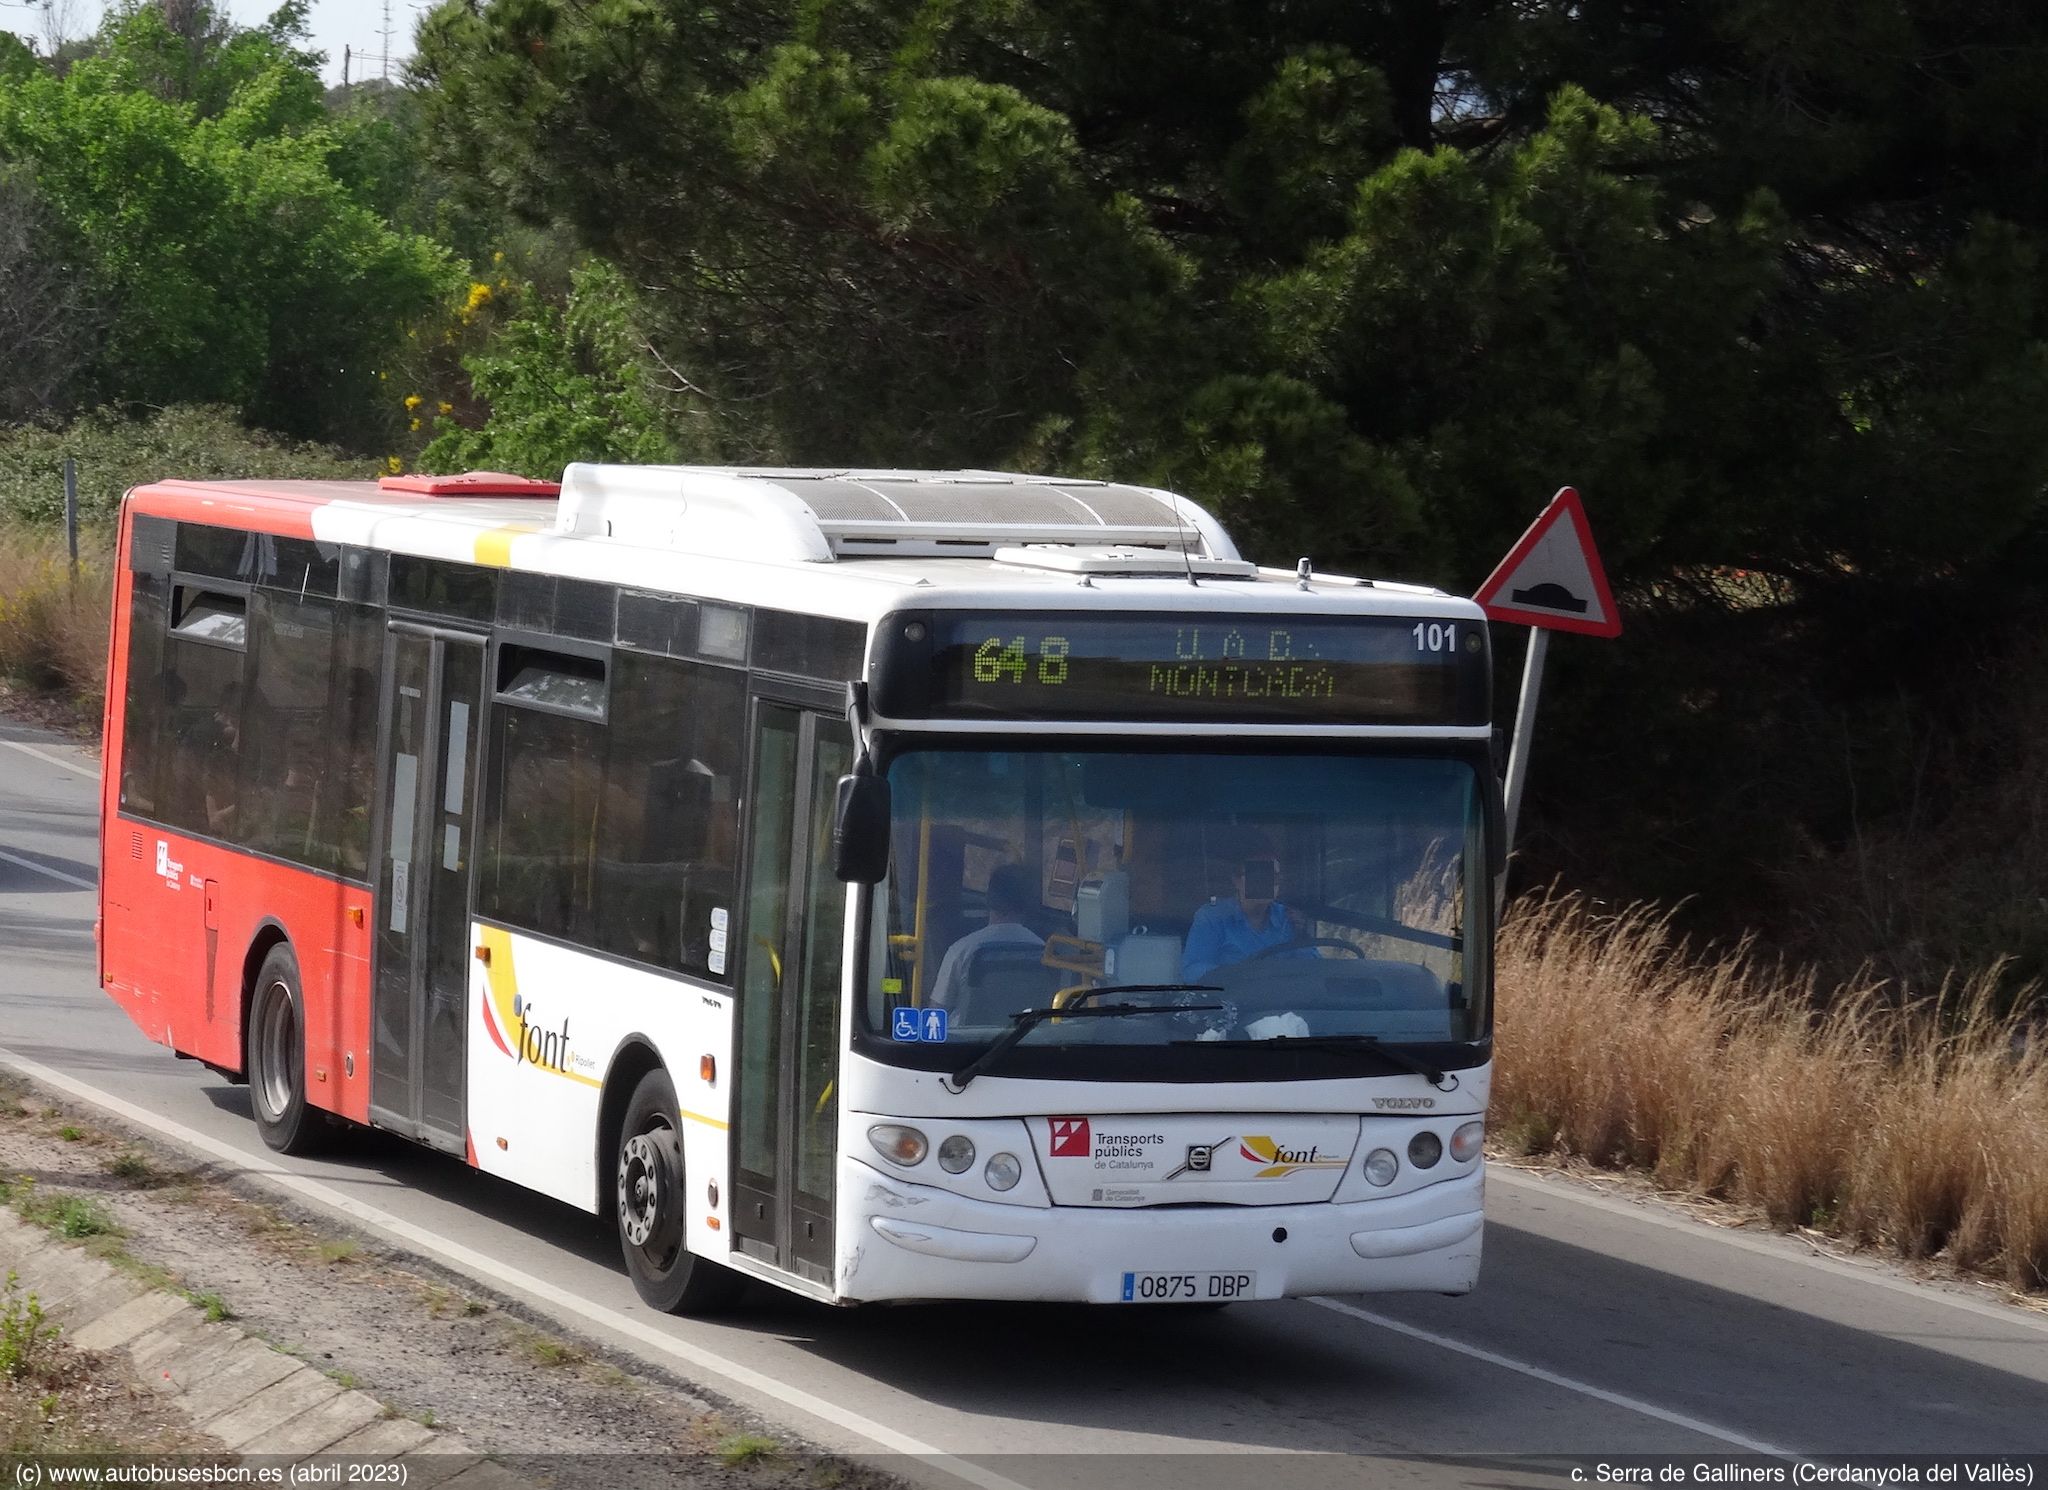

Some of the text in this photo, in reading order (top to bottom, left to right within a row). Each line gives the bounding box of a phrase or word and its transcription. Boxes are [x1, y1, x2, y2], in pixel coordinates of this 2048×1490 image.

[1412, 622, 1456, 652] 101
[974, 636, 1069, 685] 648
[517, 1002, 571, 1073] font
[1371, 1097, 1436, 1109] VOLVO
[1095, 1133, 1164, 1147] Transports
[1095, 1145, 1143, 1160] públics
[1272, 1144, 1318, 1165] font
[1094, 1160, 1154, 1171] de Catalunya
[1140, 1275, 1251, 1298] 0875 DBP
